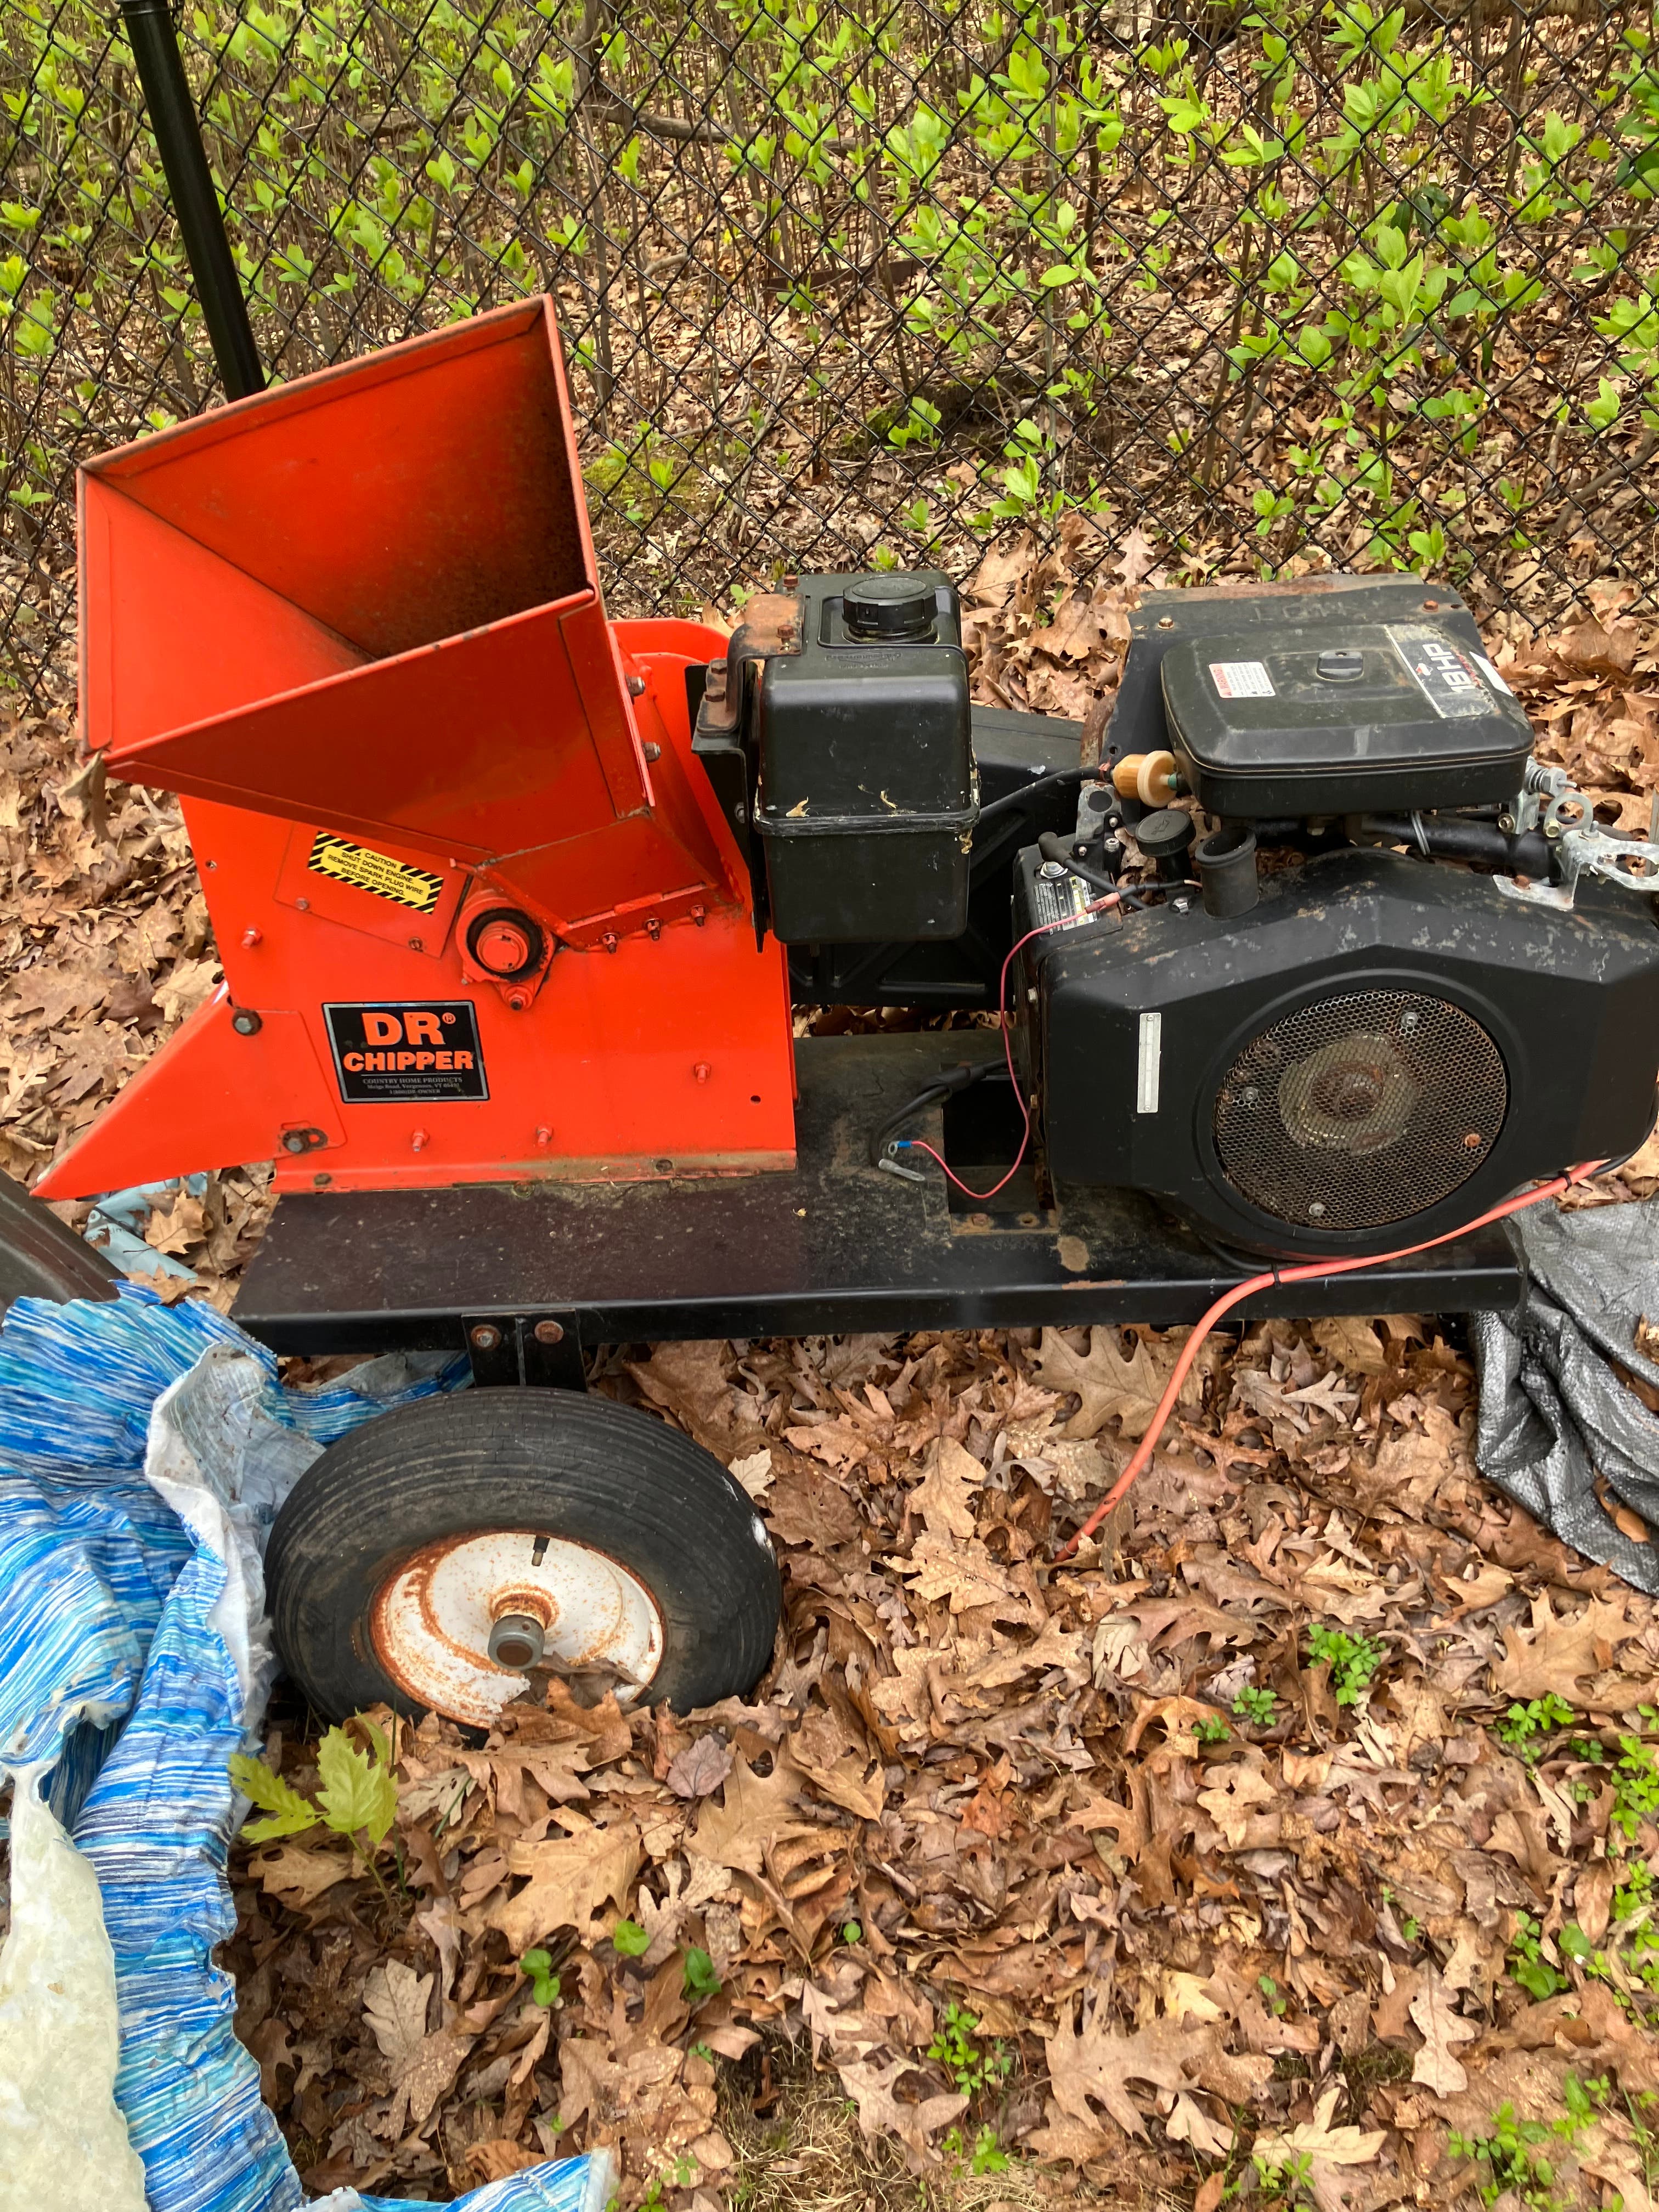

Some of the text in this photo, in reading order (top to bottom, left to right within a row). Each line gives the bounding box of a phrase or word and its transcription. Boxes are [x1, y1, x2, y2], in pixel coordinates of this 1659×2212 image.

[1213, 669, 1229, 690] WARNING
[341, 851, 414, 884] SHUT DOWN ENGINE.
[364, 853, 397, 868] CAUTION
[328, 854, 424, 895] REMOVE SPARK PLUG WIRE
[341, 867, 405, 896] BEFORE OPENING.
[343, 1051, 475, 1072] CHIPPER
